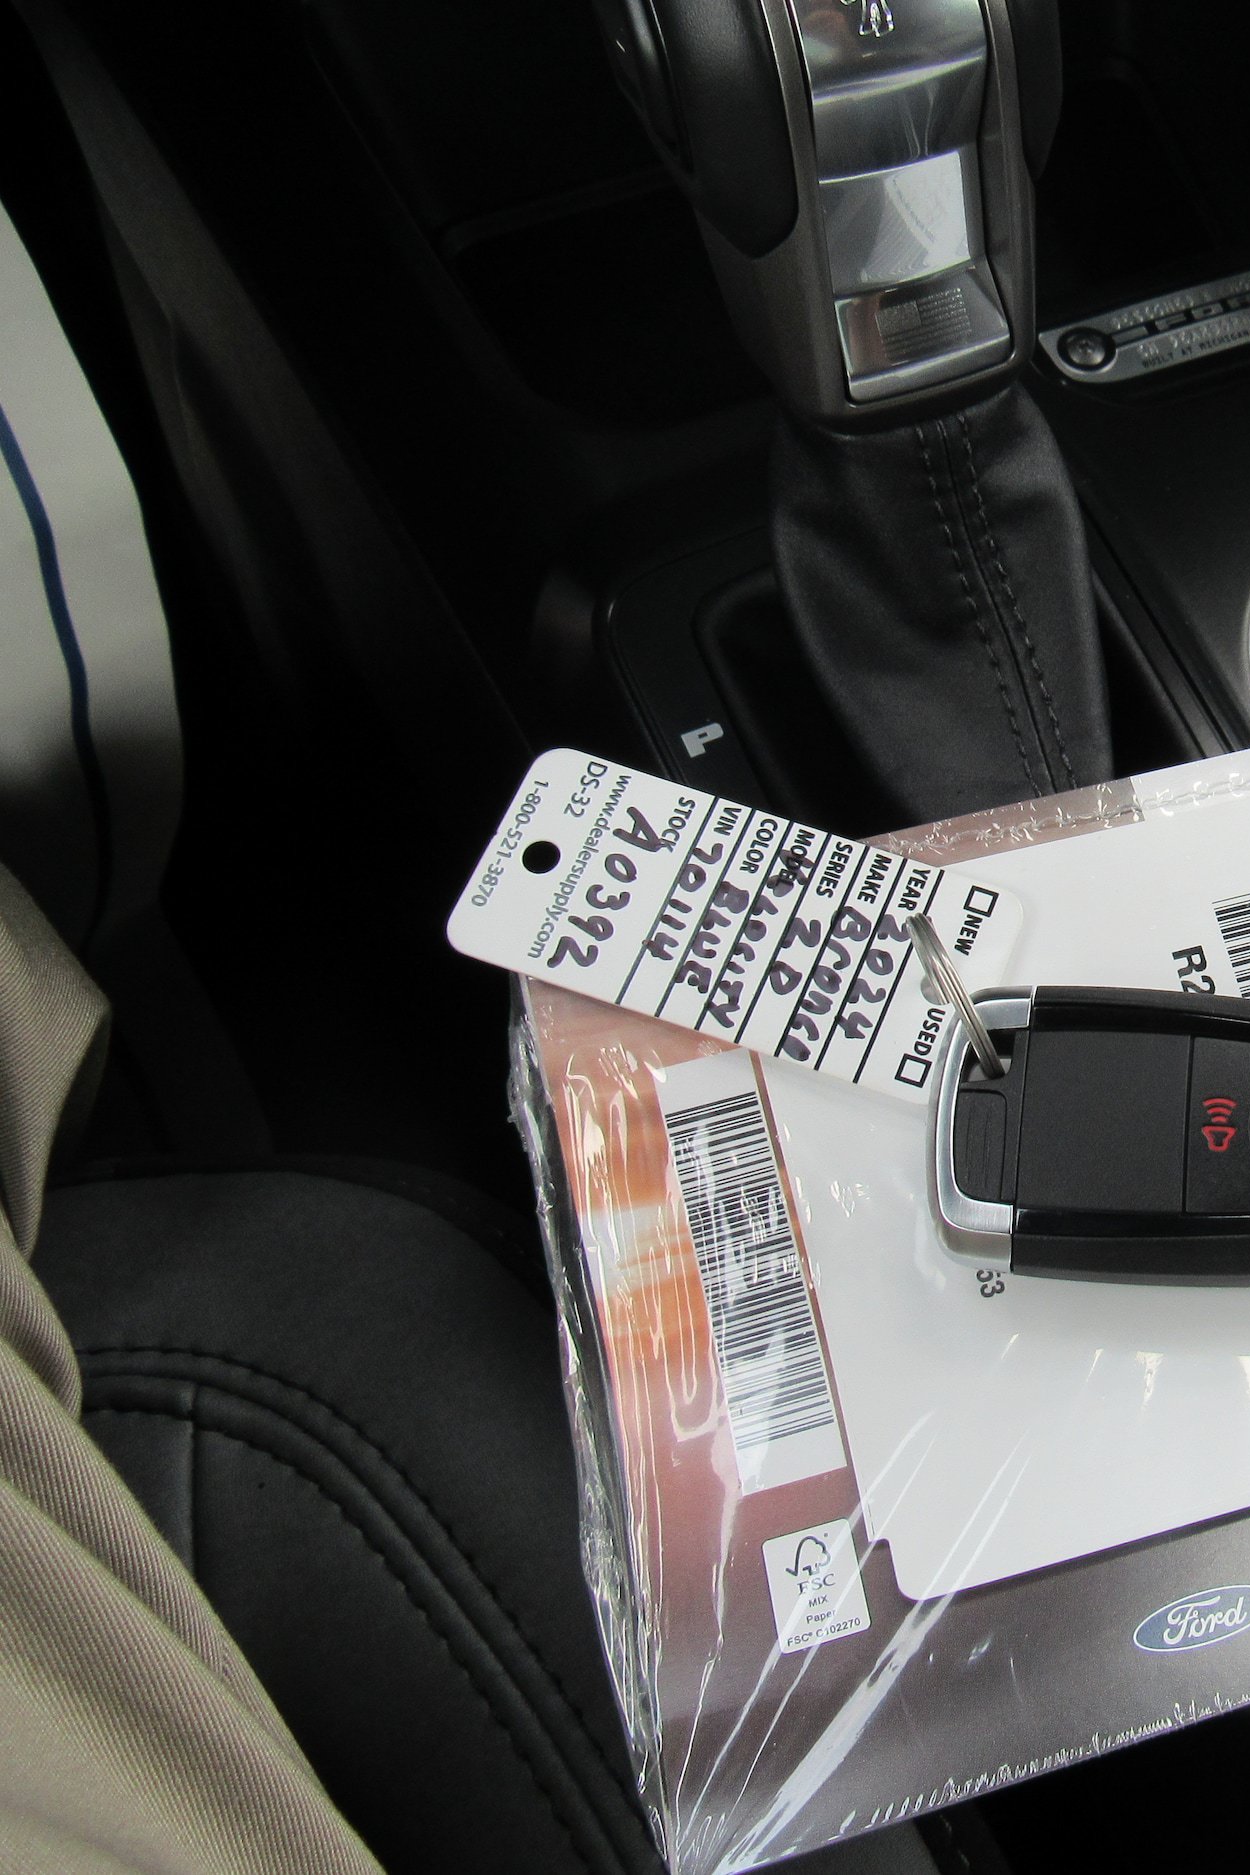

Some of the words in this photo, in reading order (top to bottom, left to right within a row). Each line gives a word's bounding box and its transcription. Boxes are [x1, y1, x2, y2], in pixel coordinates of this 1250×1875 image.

[681, 722, 724, 758] P
[564, 760, 608, 819] DS-32
[471, 780, 549, 908] 1-800-521-3870
[662, 797, 696, 853] STOCK
[714, 807, 741, 836] VIN
[740, 818, 778, 874] COLOR
[527, 775, 632, 958] www.dealersupply.com
[780, 829, 816, 888] MODEL
[816, 841, 853, 899] SERIES
[856, 853, 892, 905] MAKE
[547, 806, 661, 969] A0392
[642, 843, 724, 963] 70114
[898, 868, 930, 912] YEAR
[675, 881, 750, 994] BLUE
[954, 915, 984, 956] NEW
[835, 913, 931, 1040] 2024
[912, 1008, 944, 1057] USED
[797, 1573, 836, 1596] FSC
[808, 1594, 829, 1608] MIX
[806, 1609, 836, 1625] Paper
[1162, 1595, 1248, 1646] Ford
